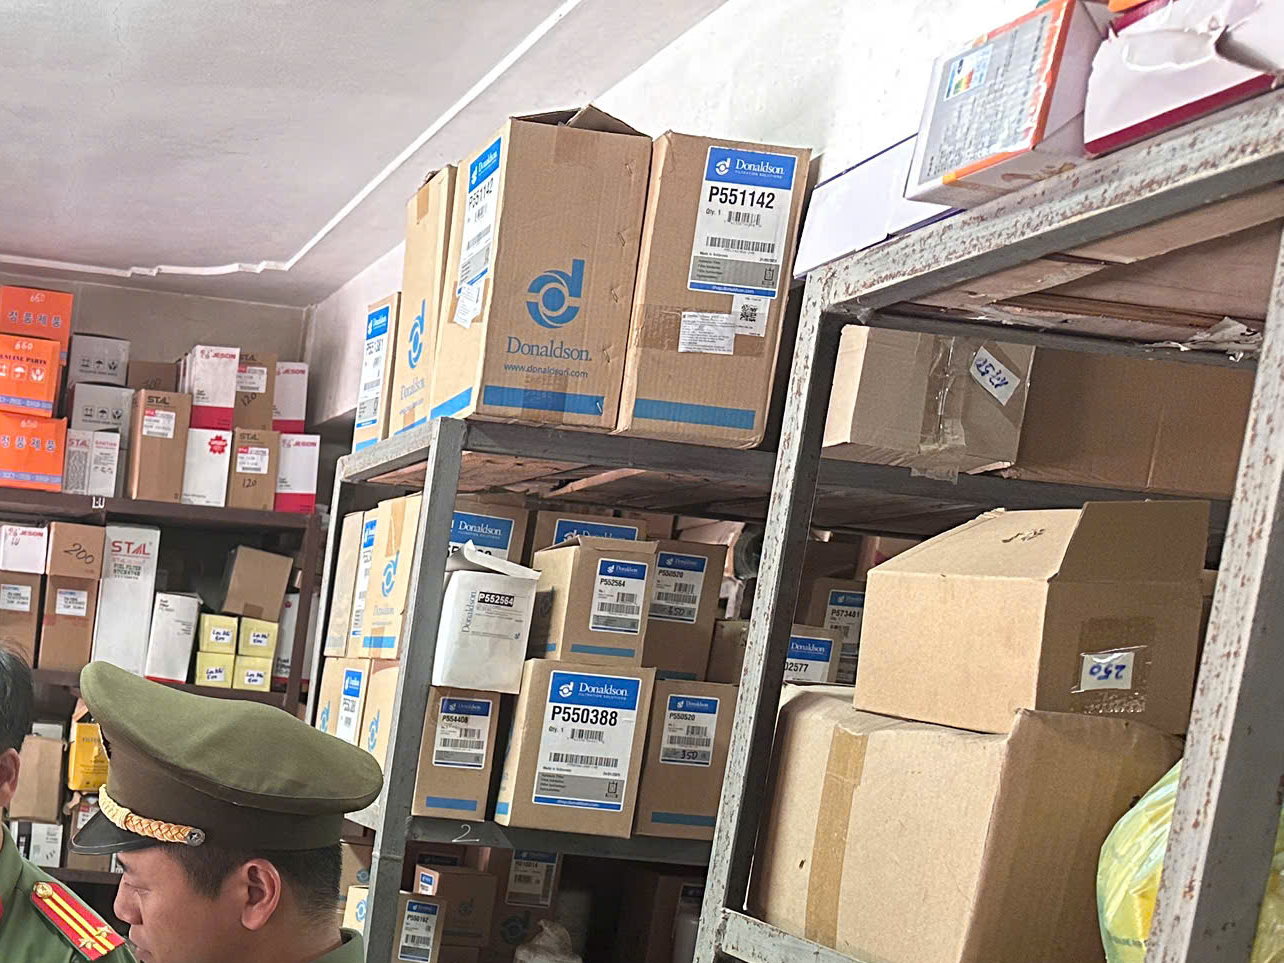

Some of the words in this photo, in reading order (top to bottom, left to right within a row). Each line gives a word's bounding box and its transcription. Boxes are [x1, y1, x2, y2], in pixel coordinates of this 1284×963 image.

[708, 185, 776, 210] P551142
[503, 363, 589, 378] www.donaldson.com
[242, 478, 257, 488] 120
[63, 542, 95, 565] 200
[111, 540, 150, 556] STAL
[784, 661, 808, 673] 02577
[550, 705, 619, 727] P550388
[451, 823, 481, 843] 2
